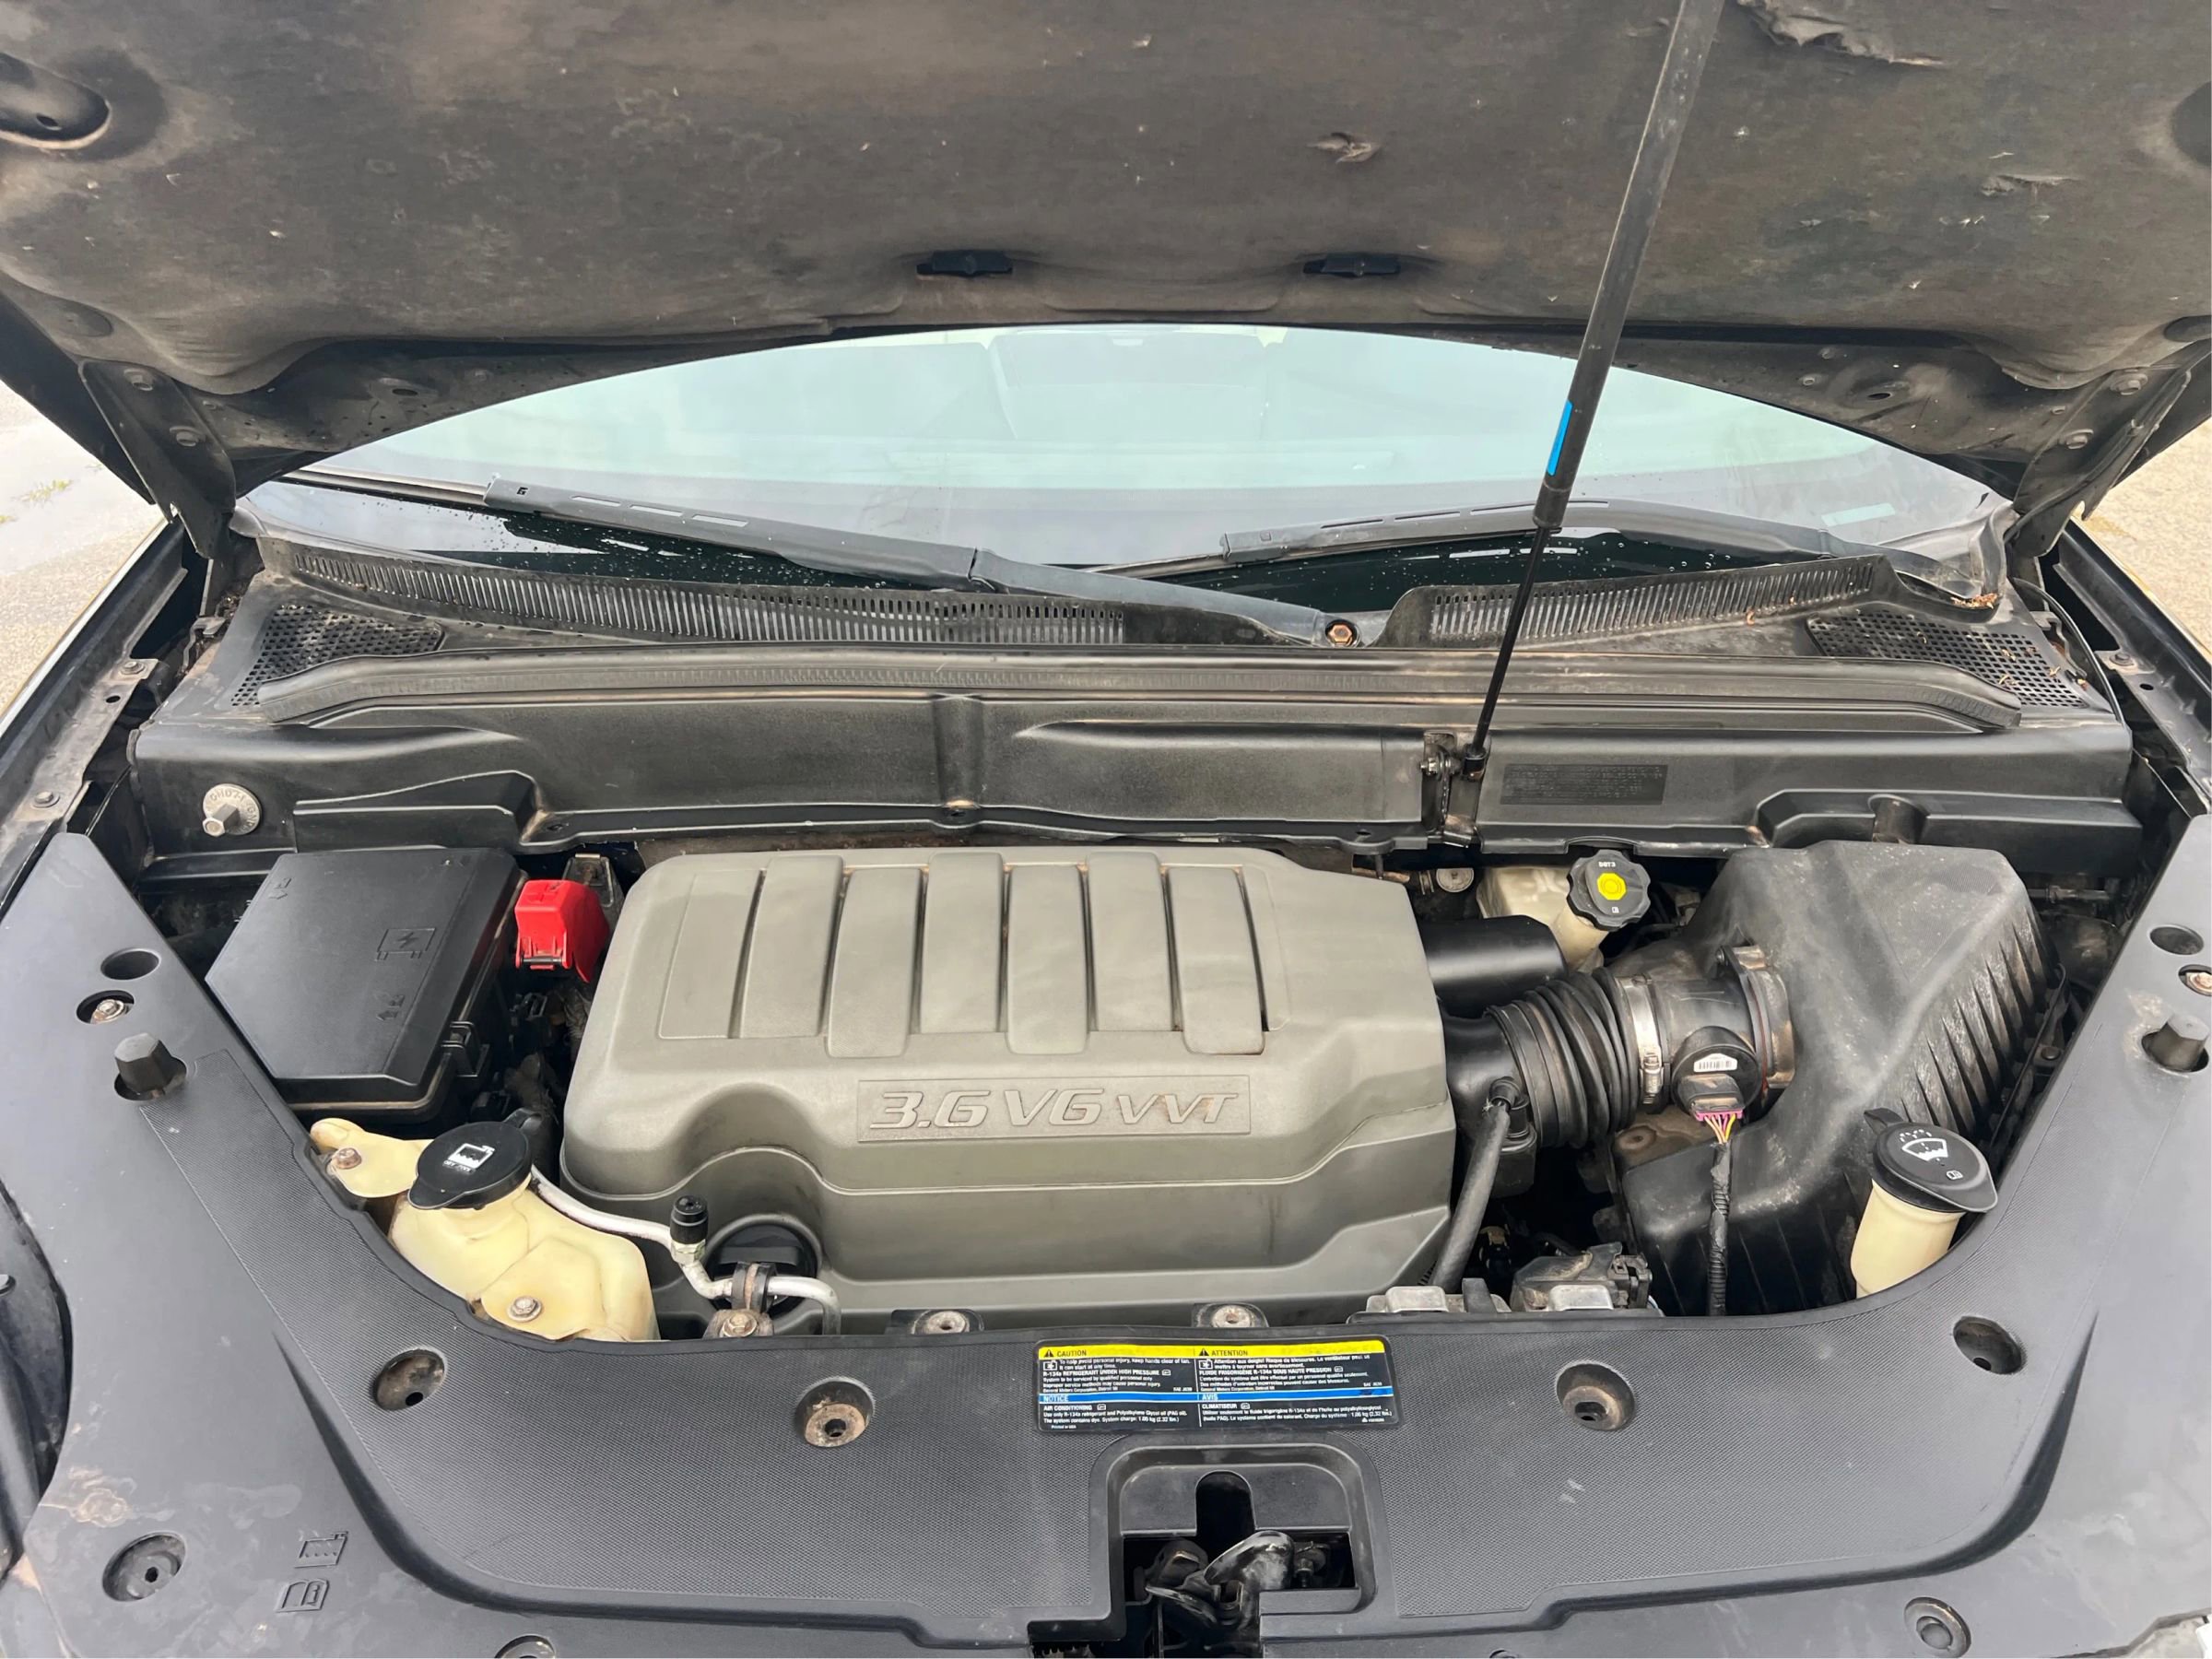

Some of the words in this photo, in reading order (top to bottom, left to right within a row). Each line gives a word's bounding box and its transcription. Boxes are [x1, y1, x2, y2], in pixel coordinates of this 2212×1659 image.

[870, 1090, 991, 1129] 3.6
[1004, 1088, 1105, 1126] V6
[1118, 1092, 1240, 1124] VVT
